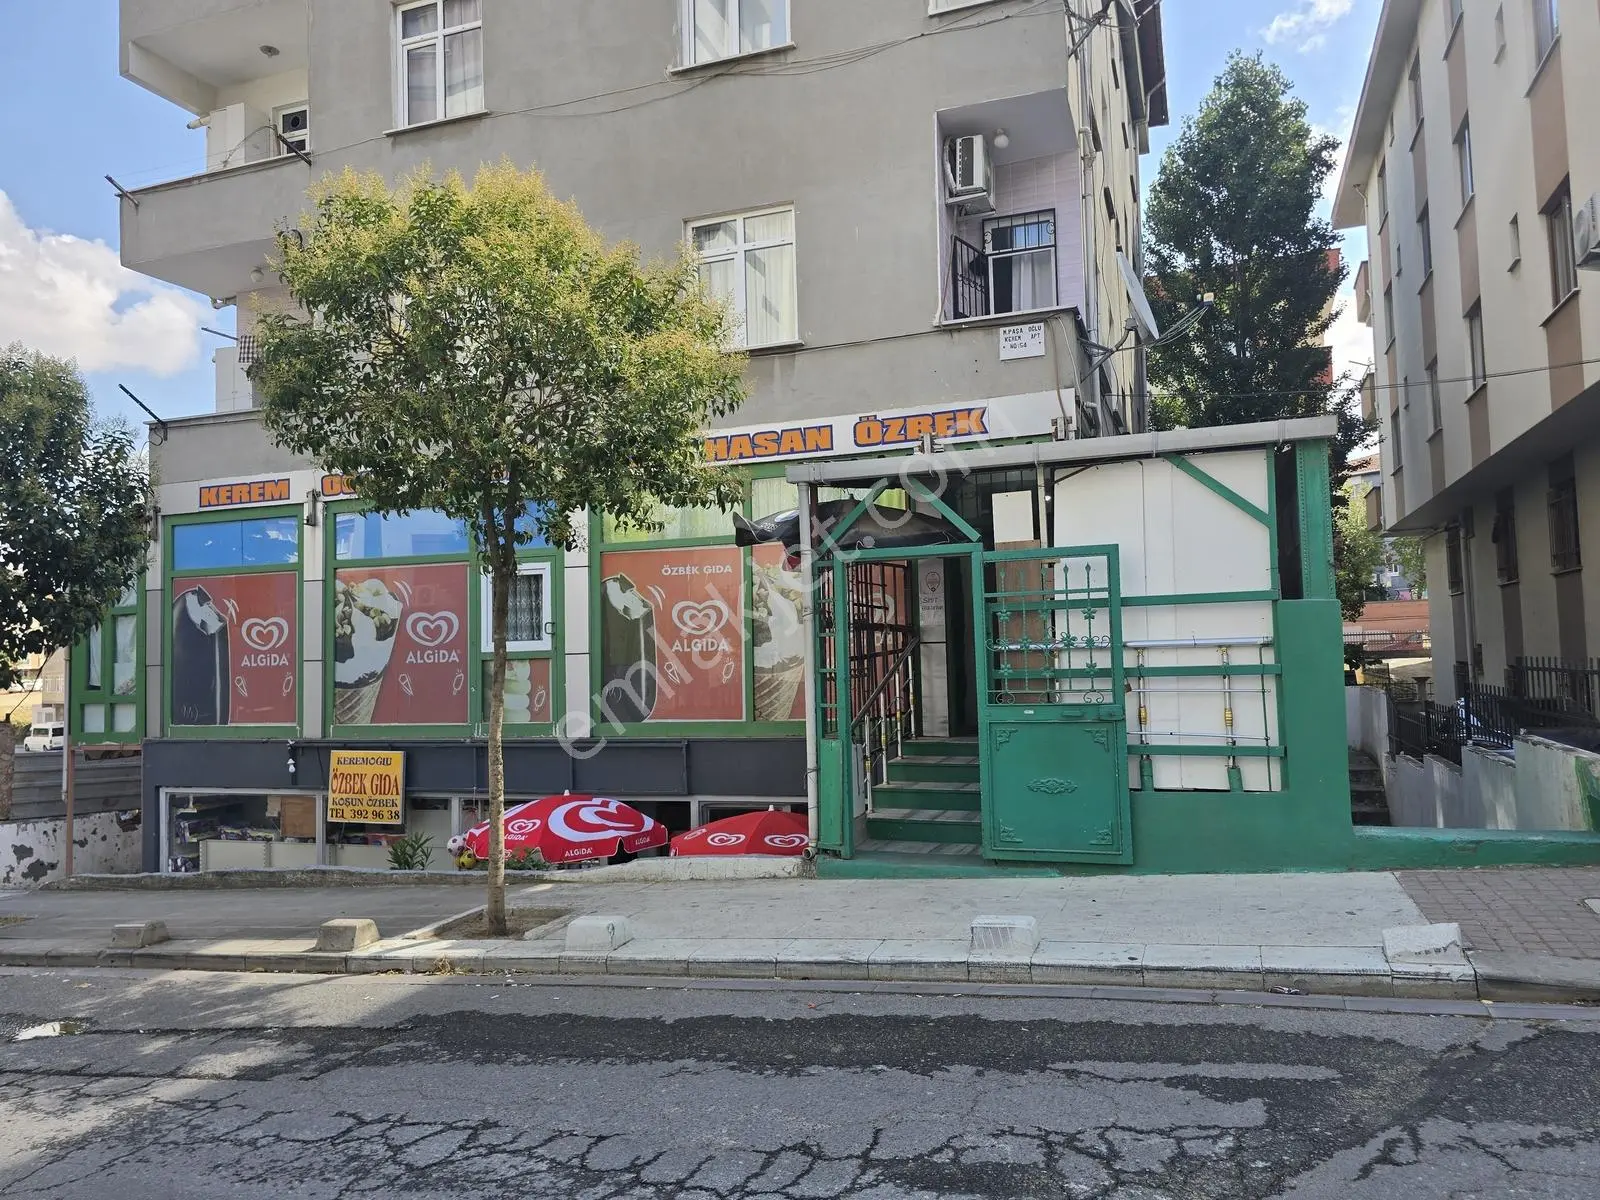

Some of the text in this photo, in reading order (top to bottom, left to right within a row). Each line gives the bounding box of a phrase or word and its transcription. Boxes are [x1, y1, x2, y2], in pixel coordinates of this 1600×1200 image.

[705, 406, 989, 462] HASAN ÖZBEK
[200, 478, 290, 508] KEREM
[661, 564, 733, 576] ÖZBEK GIDA
[331, 768, 400, 796] ÖZBEK GIDA
[332, 796, 398, 808] KOŞUN ÖZBEK
[350, 809, 369, 819] 392
[371, 809, 384, 820] 96
[387, 810, 400, 820] 38
[504, 833, 525, 841] LGiDA
